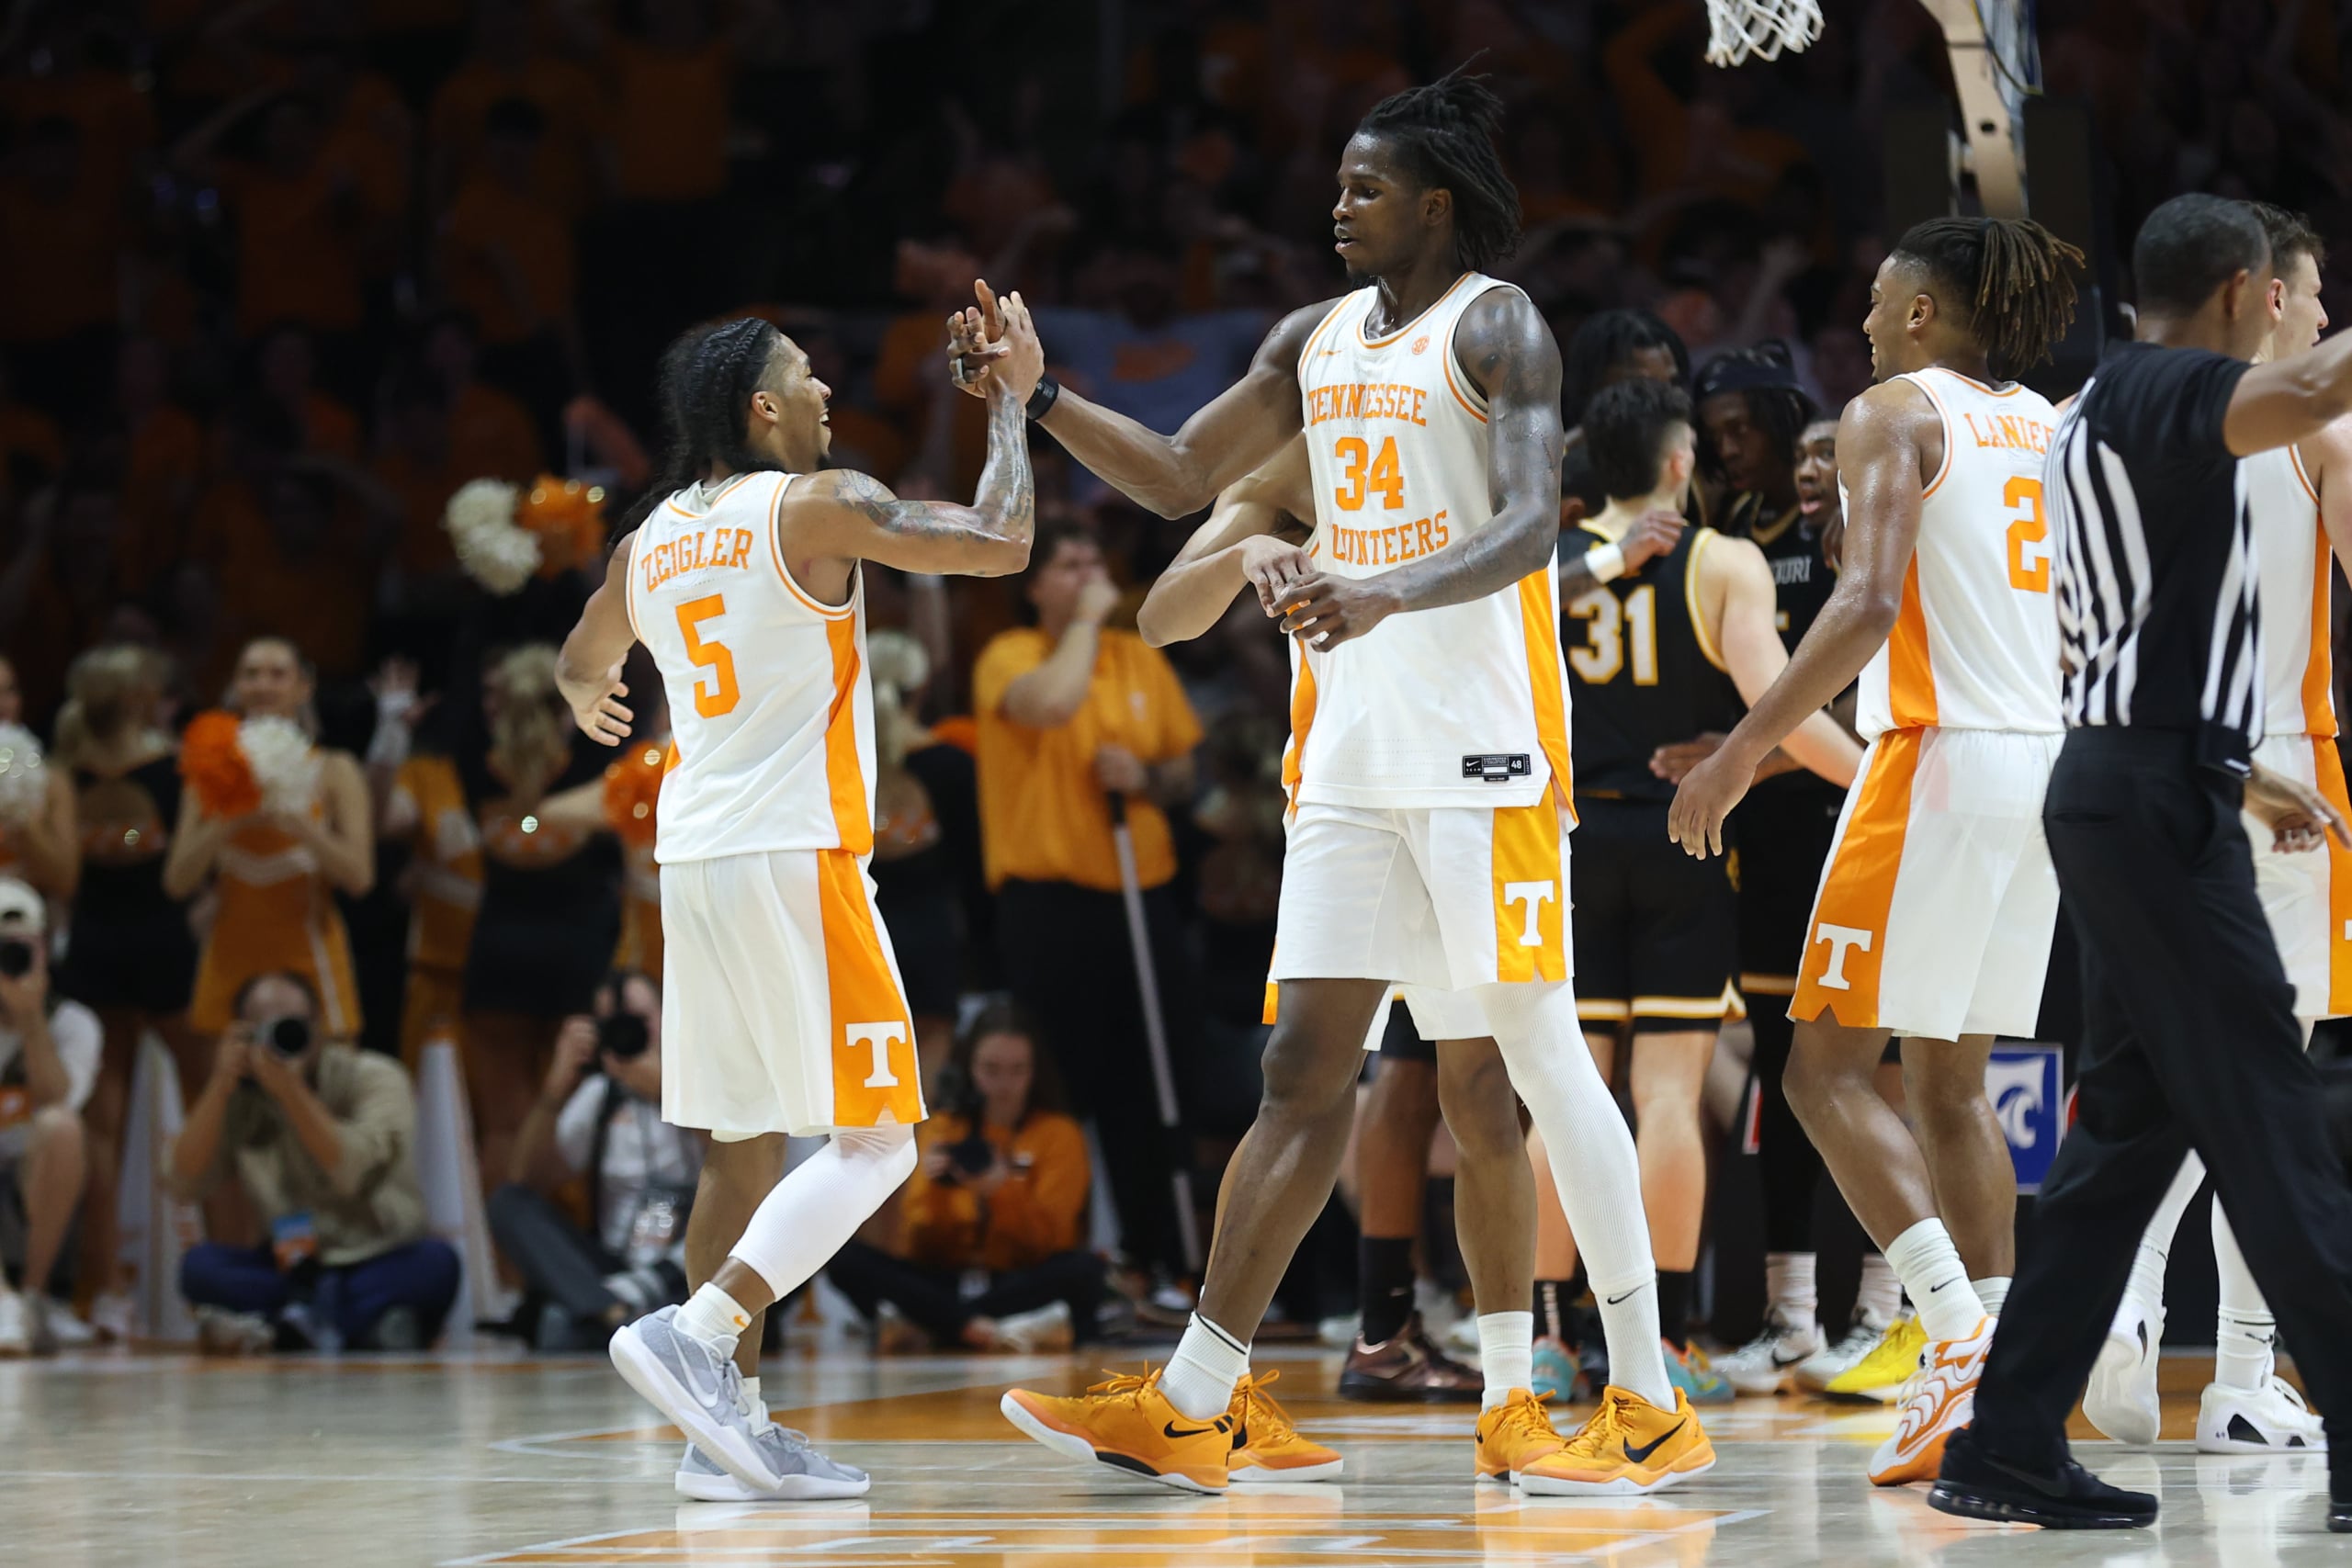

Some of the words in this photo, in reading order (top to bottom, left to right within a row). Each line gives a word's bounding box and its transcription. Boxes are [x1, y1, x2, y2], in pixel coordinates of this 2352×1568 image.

[1308, 383, 1427, 426] TENNESSEE
[1335, 435, 1404, 511] 34
[641, 528, 753, 593] ZEIGLER
[2004, 476, 2050, 593] 2
[675, 593, 741, 718] 5
[1569, 585, 1658, 686] 31
[1511, 760, 1522, 769] 48
[1505, 880, 1554, 946] T
[1815, 922, 1872, 990] T
[845, 1021, 907, 1089] T
